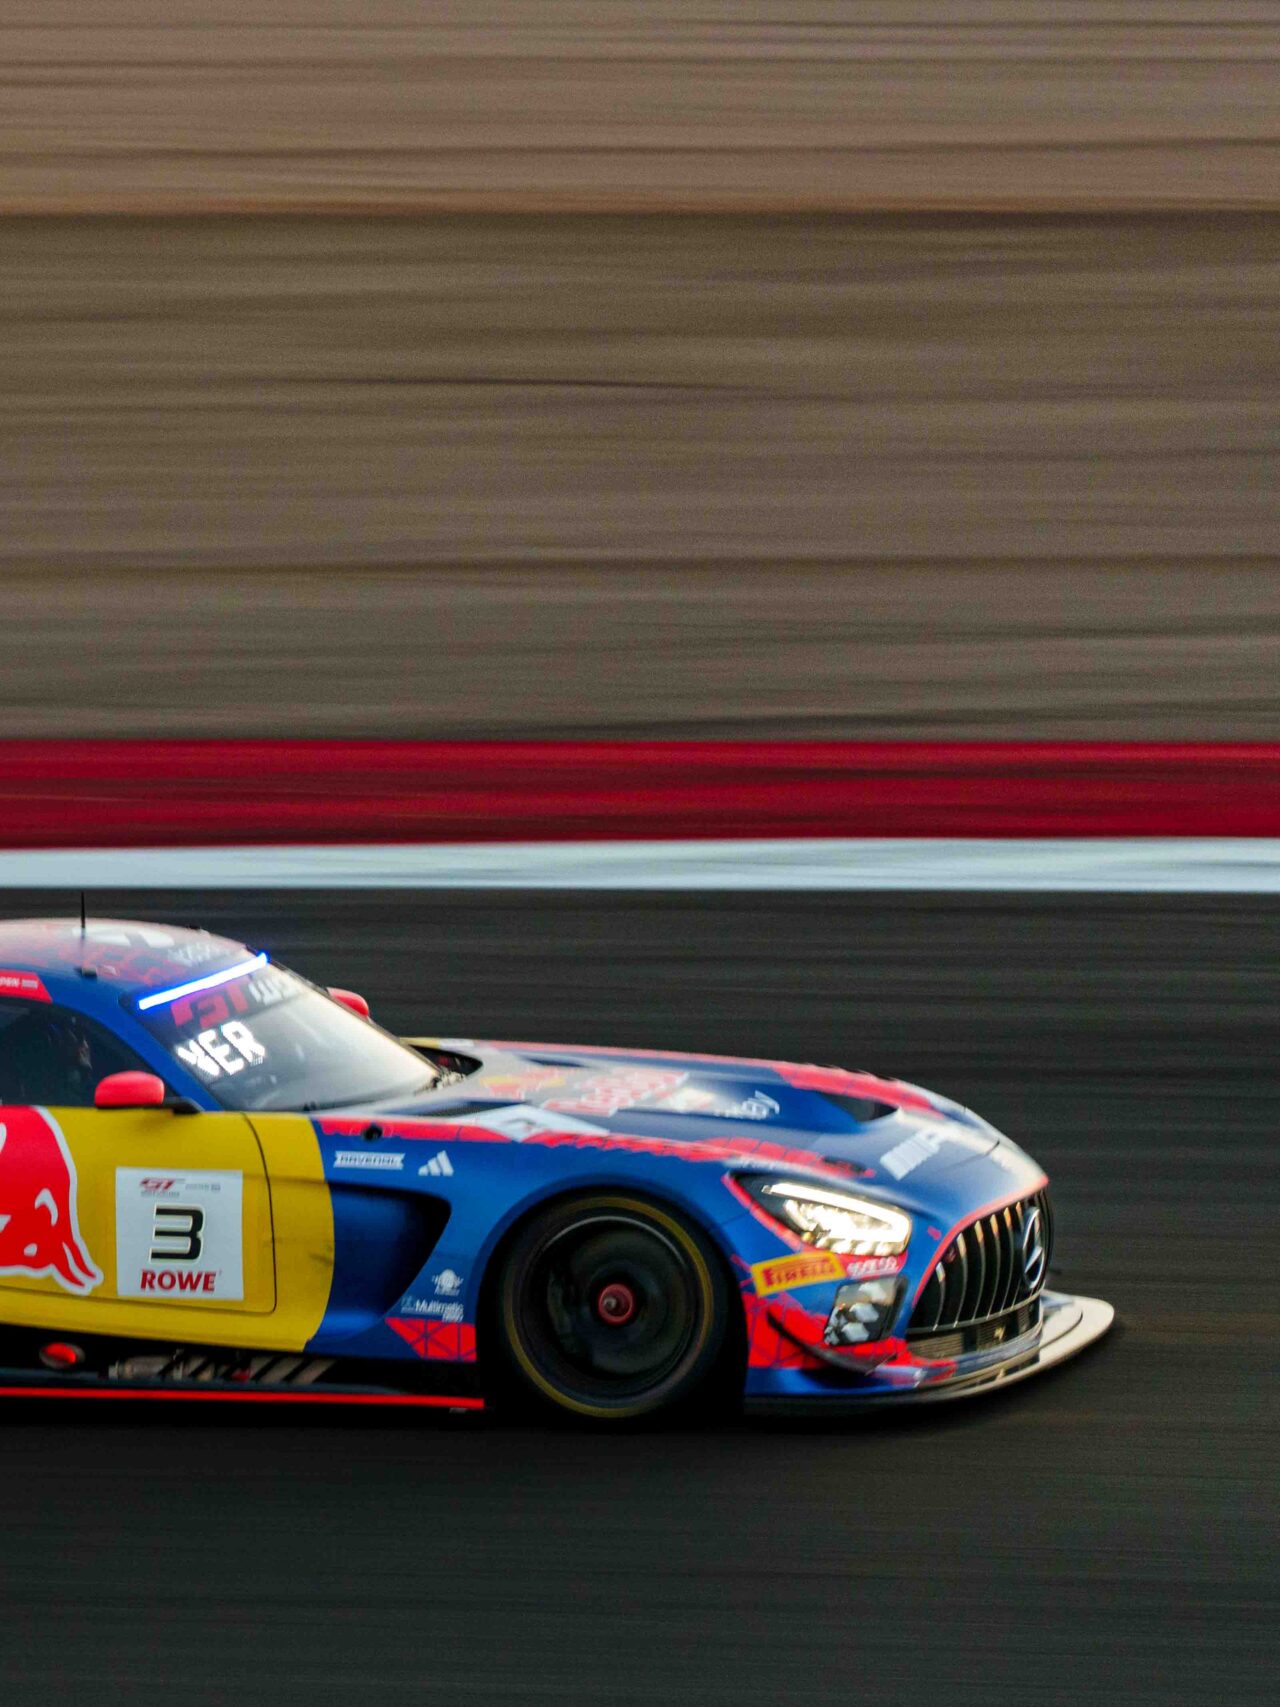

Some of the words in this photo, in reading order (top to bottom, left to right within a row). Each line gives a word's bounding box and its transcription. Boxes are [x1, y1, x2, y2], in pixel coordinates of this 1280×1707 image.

[177, 1020, 267, 1076] VER
[150, 1205, 205, 1262] 3
[140, 1268, 217, 1292] ROWE
